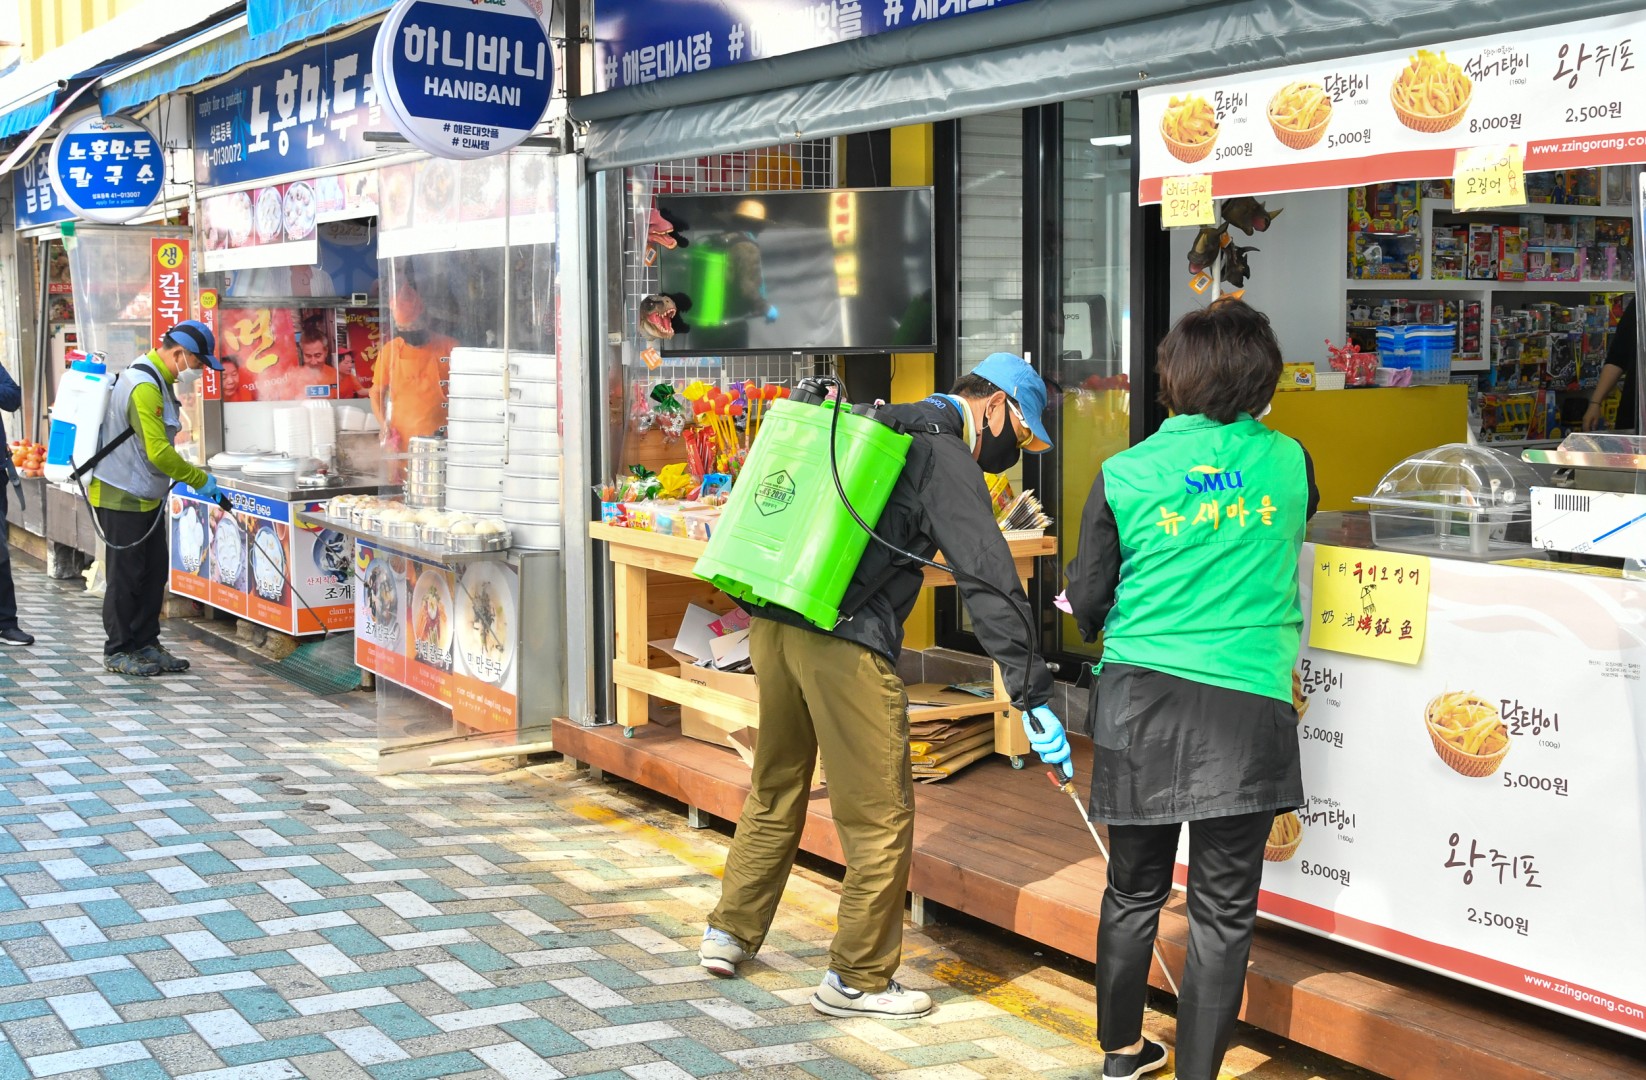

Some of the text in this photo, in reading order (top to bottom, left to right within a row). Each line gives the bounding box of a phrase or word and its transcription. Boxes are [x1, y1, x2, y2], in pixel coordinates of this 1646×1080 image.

[403, 23, 546, 81] 하니바니
[728, 23, 745, 60] #
[605, 31, 713, 89] # 해운대시장
[1464, 53, 1529, 82] 섞어탱이
[424, 76, 521, 107] HANIBANI
[1214, 73, 1369, 120] 몸탱이 달탱이
[1469, 101, 1622, 133] 8,000원 2,500원
[443, 123, 499, 139] # 해운대핫플
[1328, 129, 1371, 149] 5,000원
[68, 139, 152, 162] 노홍만두
[202, 143, 242, 168] 41-0130072
[452, 137, 490, 151] # 인싸템
[1215, 142, 1253, 160] 5,000원
[1532, 135, 1646, 154] www.zzingorang.co
[1466, 176, 1501, 194] 오징어
[1170, 199, 1200, 217] 오징어
[161, 246, 178, 266] 생
[1185, 471, 1244, 494] SMU
[1301, 658, 1342, 694] 몸탱이
[1326, 698, 1341, 708] (100g)
[1500, 699, 1559, 736] 달탱이
[1303, 725, 1344, 749] 5,000원
[1538, 739, 1561, 749] (100g)
[1503, 771, 1569, 797] 5,000원
[1300, 859, 1351, 887] 8,000원
[1467, 907, 1530, 937] 2,500원
[1524, 974, 1644, 1019] www.zzingorang.com
